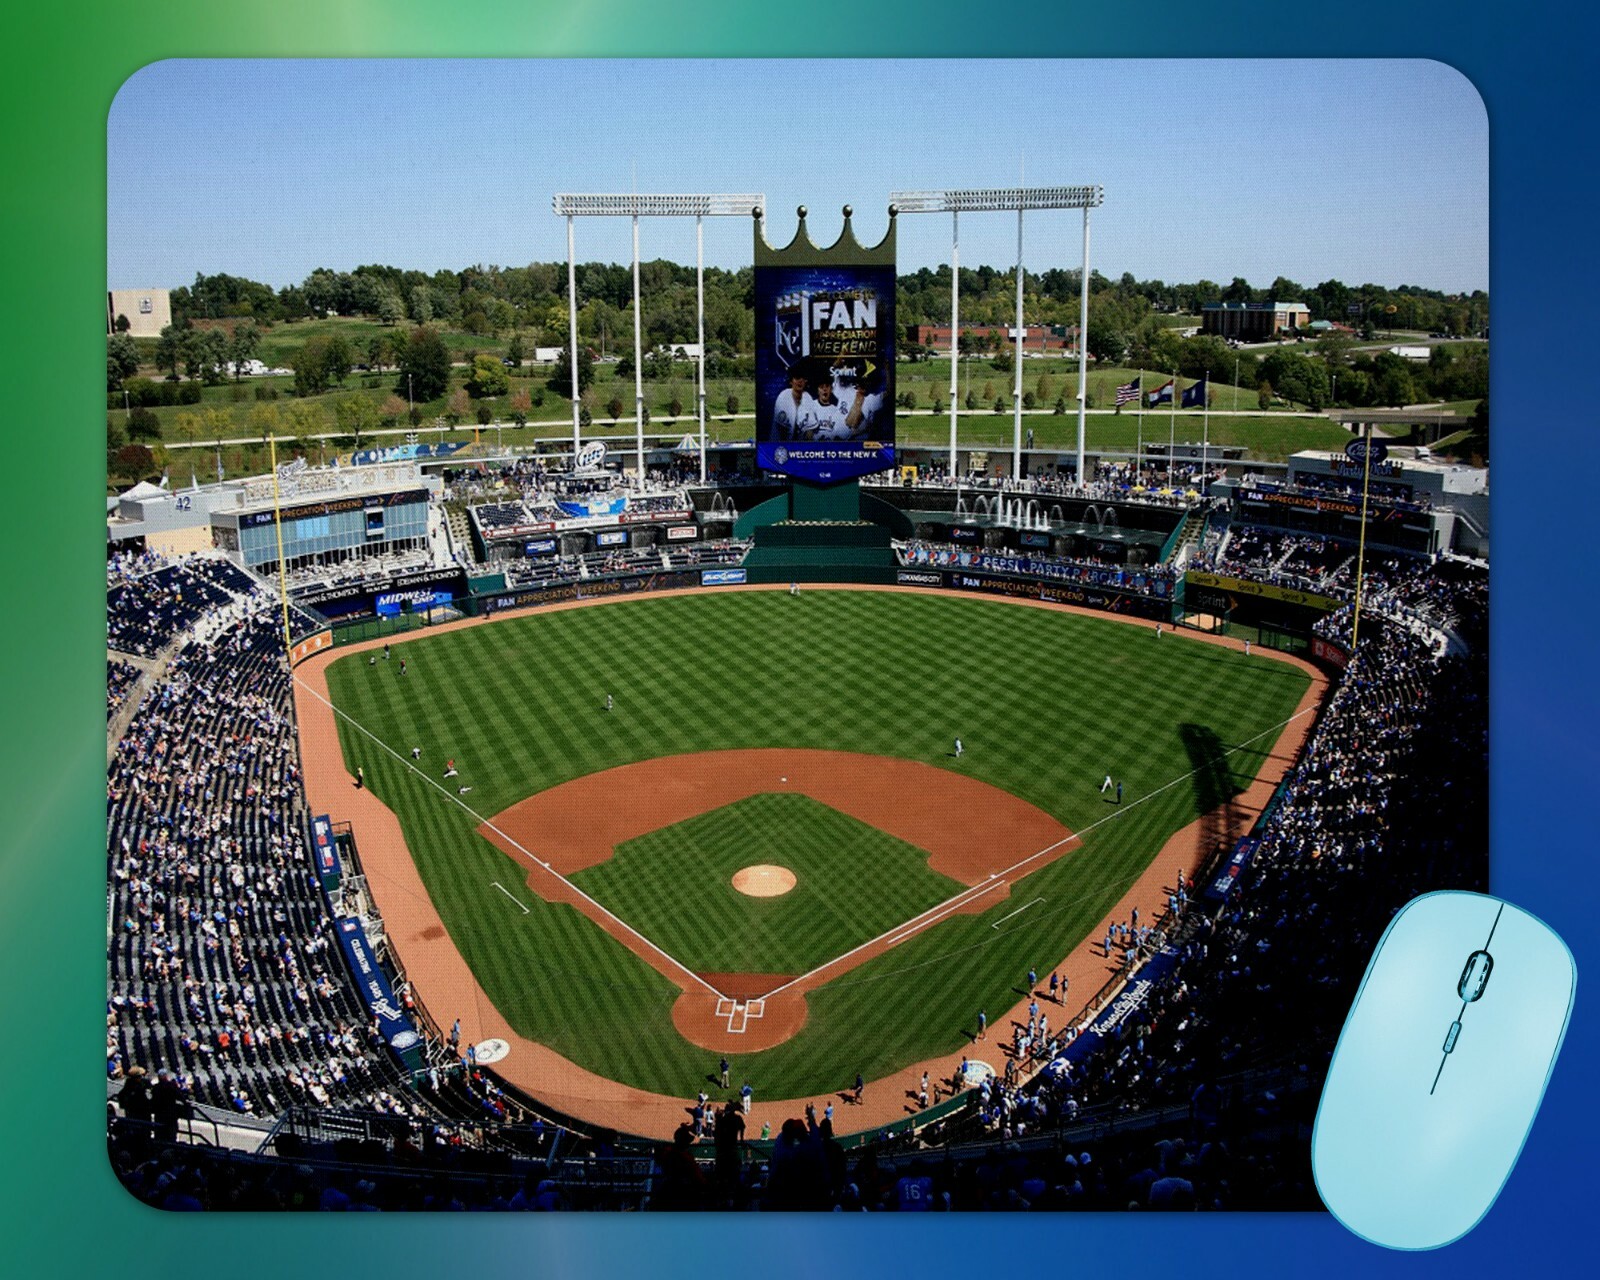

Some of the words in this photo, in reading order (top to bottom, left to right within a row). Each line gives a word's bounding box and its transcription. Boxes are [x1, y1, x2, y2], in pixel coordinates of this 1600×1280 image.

[812, 300, 877, 330] FAN
[813, 340, 877, 354] WEEKEND
[829, 365, 858, 379] Sprint
[788, 450, 825, 459] WELCOME
[826, 450, 837, 459] TO
[838, 450, 852, 459] THE
[853, 450, 870, 459] NEW
[871, 450, 878, 459] K
[175, 496, 192, 512] 42
[1247, 492, 1264, 501] FAN
[1264, 494, 1317, 509] APPRECIATION
[1319, 501, 1357, 514] WEEKEND
[255, 513, 272, 524] FAN
[327, 500, 364, 512] WEEKEND
[430, 569, 461, 581] THOMPSON
[983, 556, 1019, 571] PEPSI
[1030, 562, 1070, 577] PARTY
[497, 598, 516, 608] FAN
[515, 587, 577, 604] APPRECIATION
[579, 582, 622, 597] WEEKEND
[962, 576, 981, 587] FAN
[981, 579, 1041, 595] APPRECIATION
[1043, 587, 1085, 602] WEEKEND
[1197, 592, 1226, 609] Sprint
[904, 1183, 921, 1200] 16
